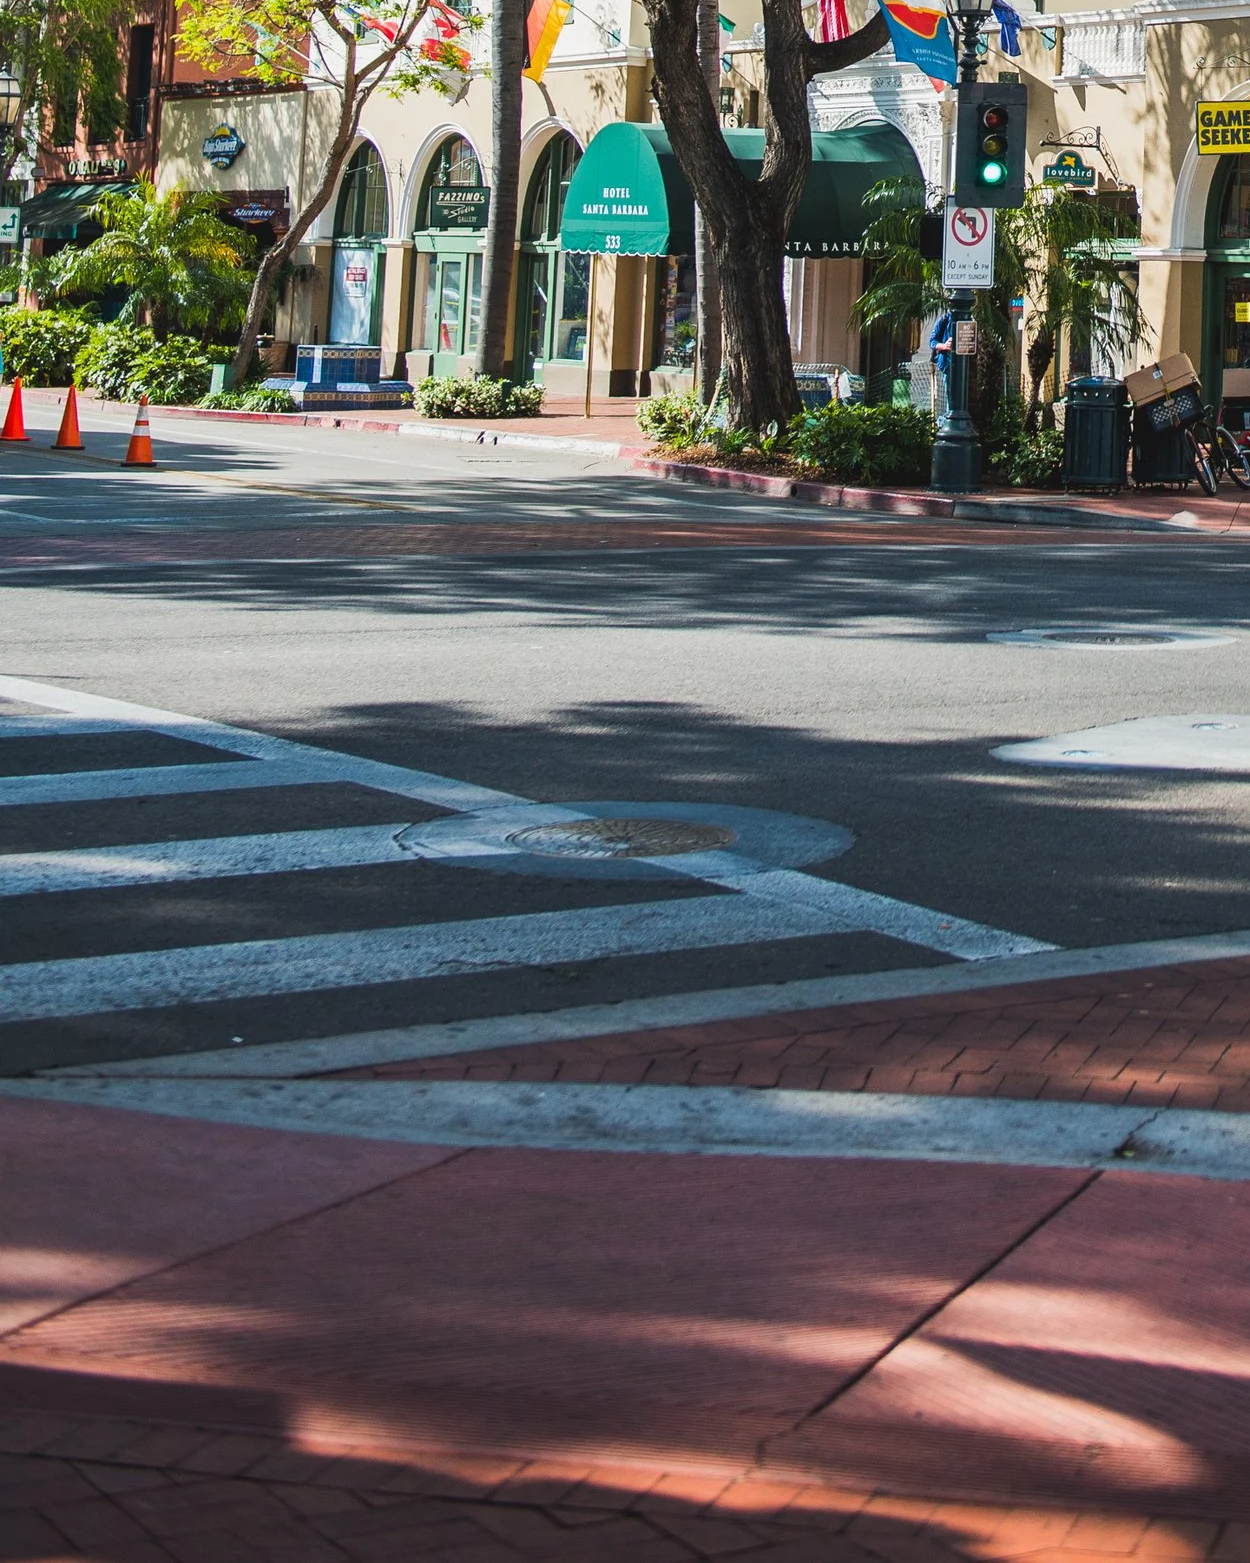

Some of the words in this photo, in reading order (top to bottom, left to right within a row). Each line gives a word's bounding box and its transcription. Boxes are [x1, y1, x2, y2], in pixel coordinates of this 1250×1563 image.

[1047, 167, 1092, 177] lovebird
[603, 187, 630, 198] HOTEL
[582, 204, 609, 214] SANTA
[612, 205, 649, 215] BARBARA
[605, 235, 621, 249] 533
[784, 241, 813, 252] NTA
[947, 260, 956, 269] 10
[973, 260, 979, 270] 6
